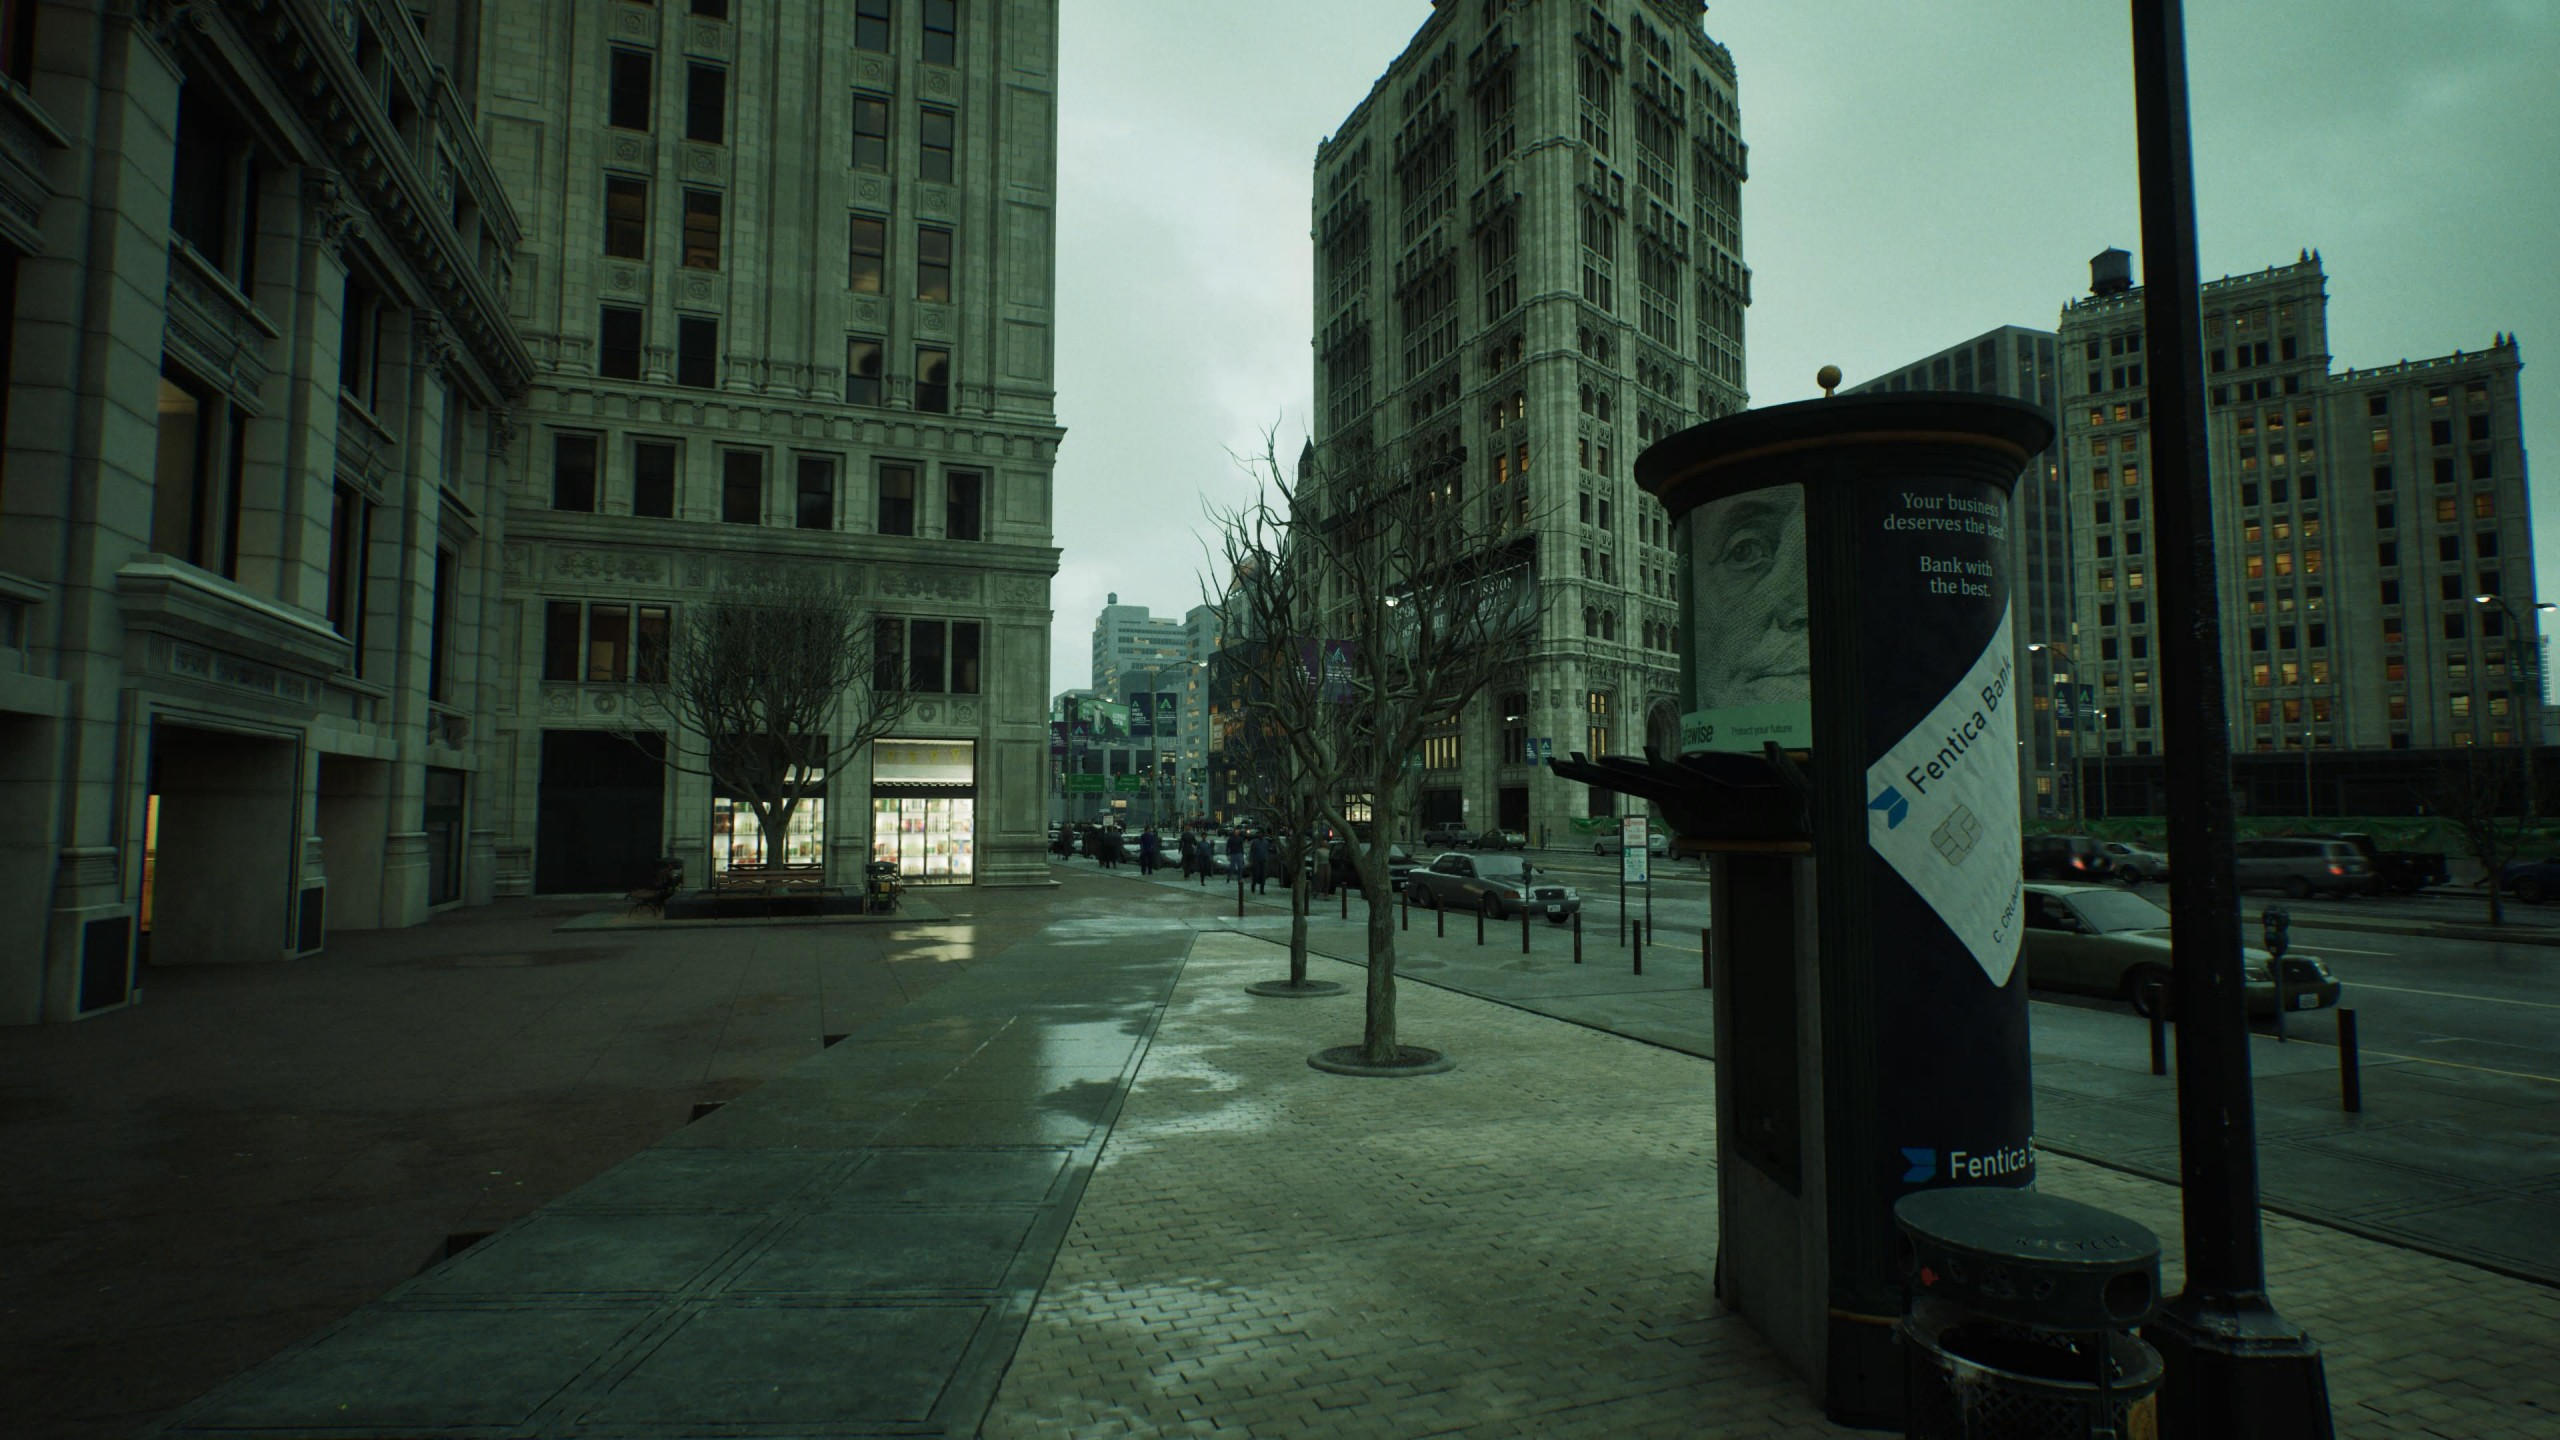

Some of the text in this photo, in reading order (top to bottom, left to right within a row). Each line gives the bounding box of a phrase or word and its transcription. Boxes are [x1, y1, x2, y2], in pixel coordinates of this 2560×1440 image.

[1902, 491, 1999, 518] Your business
[1883, 513, 1962, 532] deserves
[1965, 516, 1985, 535] the
[1920, 555, 1993, 577] Bank with
[1930, 576, 1992, 598] the best.
[1906, 655, 2012, 795] Fentica Bank
[1951, 1145, 2027, 1180] Fentica
